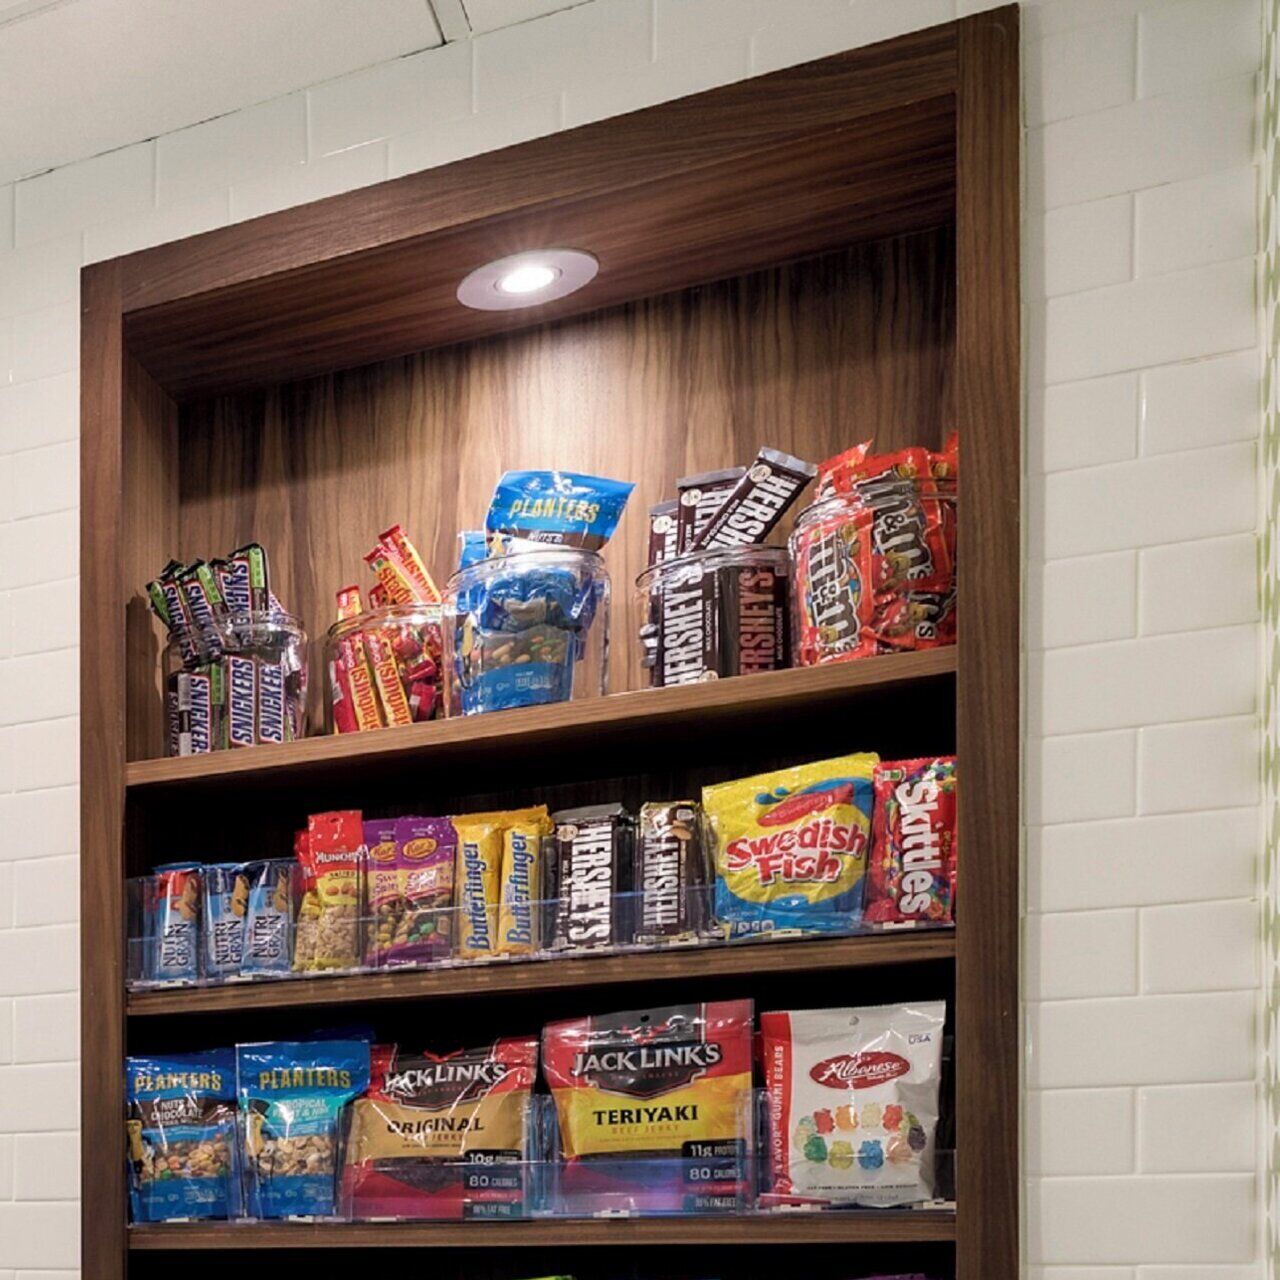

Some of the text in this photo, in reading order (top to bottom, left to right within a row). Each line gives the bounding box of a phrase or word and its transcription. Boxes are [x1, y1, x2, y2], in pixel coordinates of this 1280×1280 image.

[509, 497, 600, 524] PLANTERS
[740, 567, 775, 674] ERSHEY'S
[191, 677, 210, 754] SNICKER
[232, 658, 255, 745] SNICKERS
[726, 819, 867, 870] Swedish
[896, 781, 942, 914] Skittles
[570, 822, 612, 944] HERSHEY'S
[756, 851, 842, 884] Fish
[463, 842, 490, 950] Butterfinger
[506, 832, 534, 944] Butterfinger
[571, 1043, 721, 1076] JACK LINK'S
[773, 1045, 784, 1080] BEARS
[134, 1073, 222, 1093] PLANTERS
[259, 1067, 351, 1090] PLANTERS
[381, 1064, 507, 1093] JACK LINK'S
[387, 1117, 484, 1133] ORIGINAL
[592, 1105, 699, 1126] TERIYAKI
[469, 1175, 489, 1187] 80
[690, 1168, 710, 1180] 80
